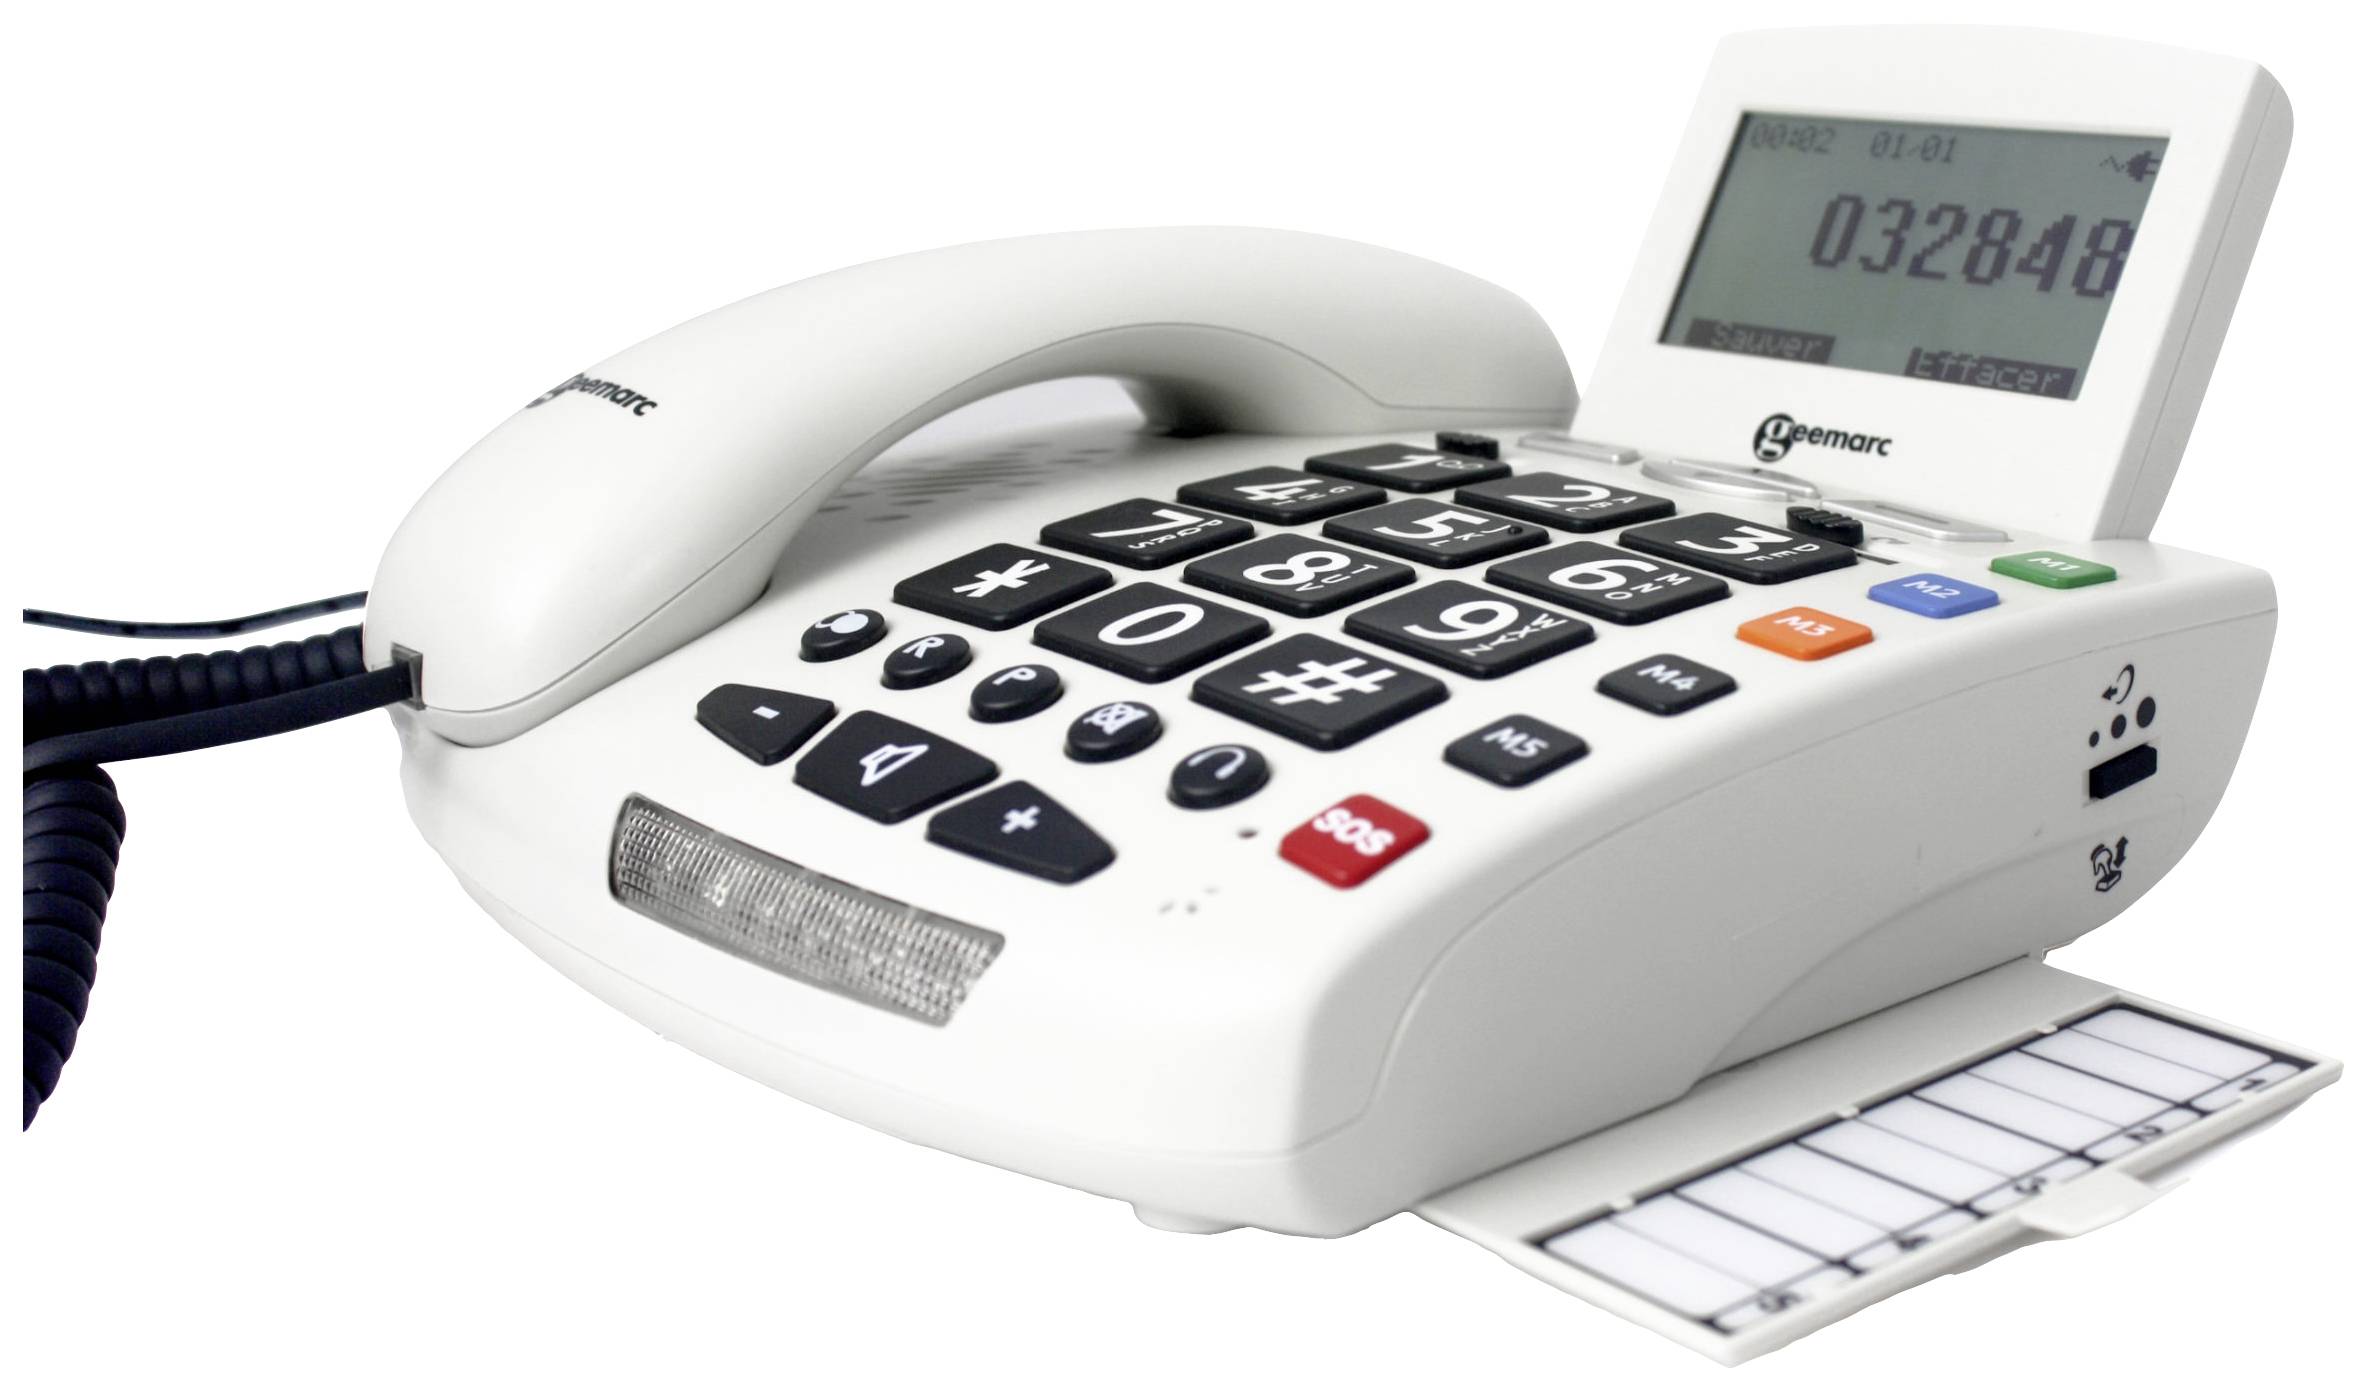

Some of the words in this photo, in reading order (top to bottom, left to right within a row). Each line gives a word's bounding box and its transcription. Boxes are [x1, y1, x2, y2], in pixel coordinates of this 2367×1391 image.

[1808, 194, 2136, 299] 032848
[1709, 320, 1823, 360] Sauver
[1912, 347, 2061, 395] Effacer
[1752, 412, 1893, 463] geemarc
[1366, 453, 1446, 471] 1
[1233, 477, 1325, 502] 4
[1504, 483, 1612, 509] 2
[1090, 508, 1206, 538] 7
[1371, 508, 1491, 540] 5
[1673, 524, 1793, 556] 3
[1241, 549, 1353, 586] 8
[1547, 558, 1661, 592] 6
[2028, 556, 2080, 572] M1
[1901, 579, 1961, 600] M2
[1401, 599, 1521, 642] 9
[1772, 614, 1836, 637] M3
[901, 635, 946, 660] R
[991, 666, 1037, 686] P
[1636, 663, 1700, 692] M4
[1483, 726, 1549, 758] M5
[1311, 806, 1397, 856] SOS
